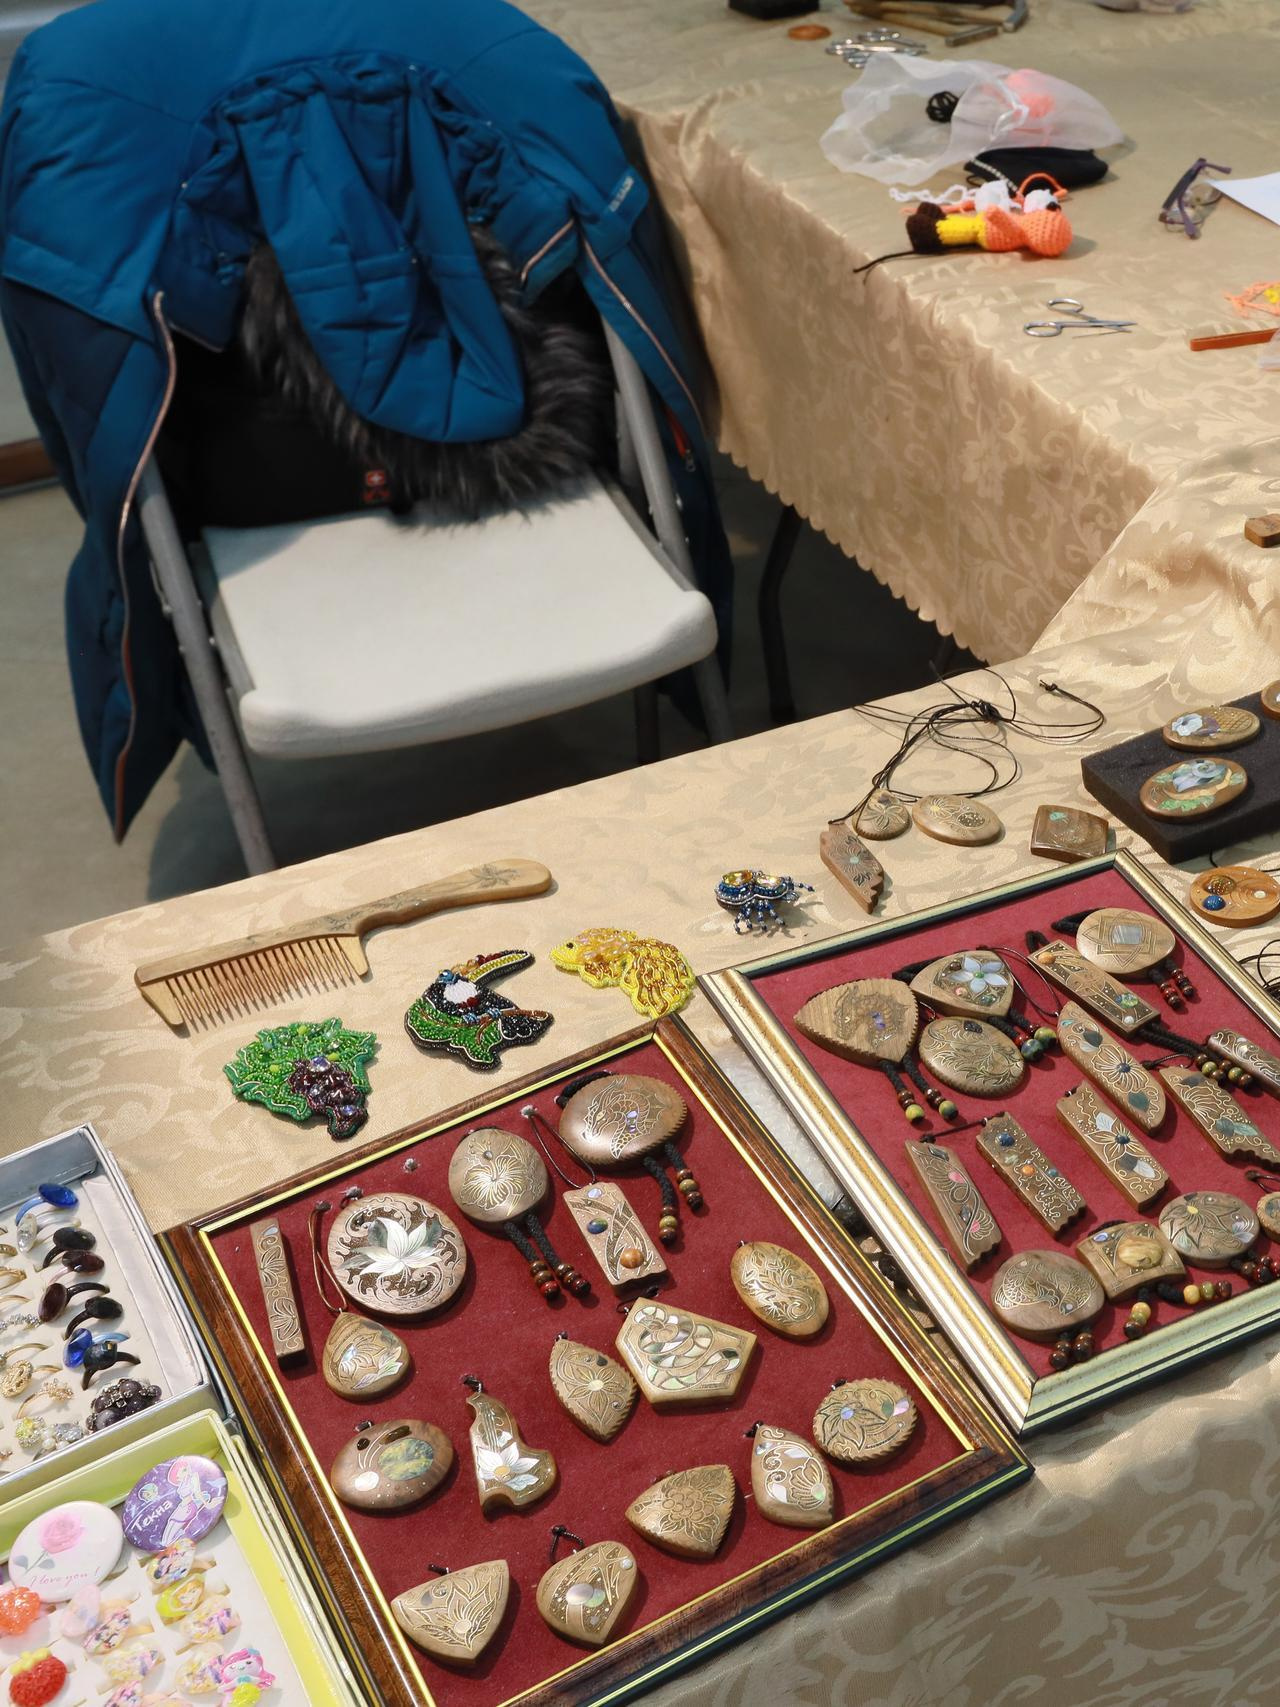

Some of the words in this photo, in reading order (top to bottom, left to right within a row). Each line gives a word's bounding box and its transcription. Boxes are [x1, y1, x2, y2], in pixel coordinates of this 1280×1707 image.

[131, 1500, 173, 1532] Текна
[39, 1574, 61, 1585] love
[64, 1573, 89, 1588] you
